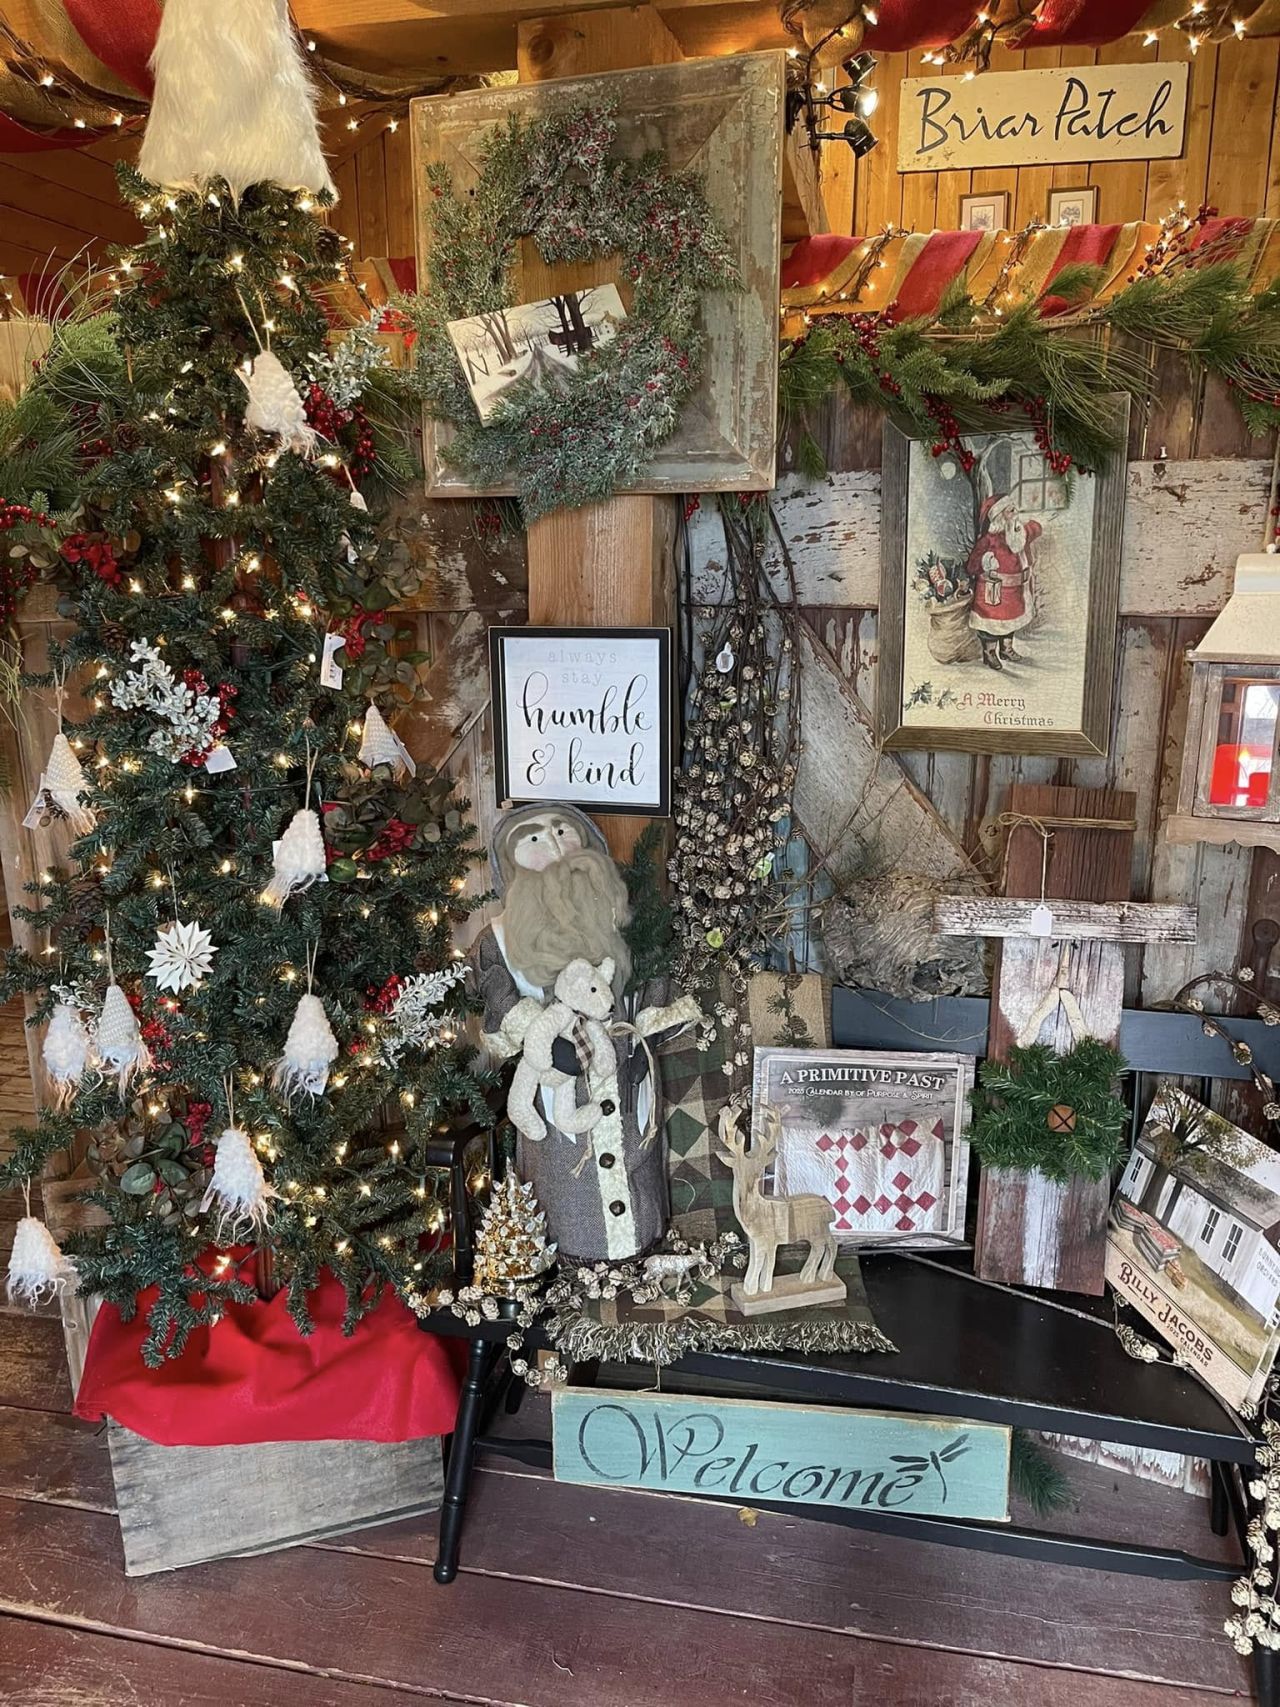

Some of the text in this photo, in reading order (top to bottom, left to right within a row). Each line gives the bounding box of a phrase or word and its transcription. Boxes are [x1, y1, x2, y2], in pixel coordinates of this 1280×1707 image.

[916, 77, 1174, 154] Briar Patch
[548, 651, 617, 665] always
[562, 671, 602, 686] stay
[516, 671, 652, 735] humble
[956, 692, 1026, 710] A Merry
[983, 711, 1054, 727] Christmas
[526, 737, 645, 789] & kind
[780, 1068, 945, 1091] A PRIMITIVE PAST
[1117, 1261, 1214, 1362] BILLY JACOBS
[1166, 1324, 1209, 1368] 2025 CALENDAR
[578, 1404, 924, 1507] Welcome
